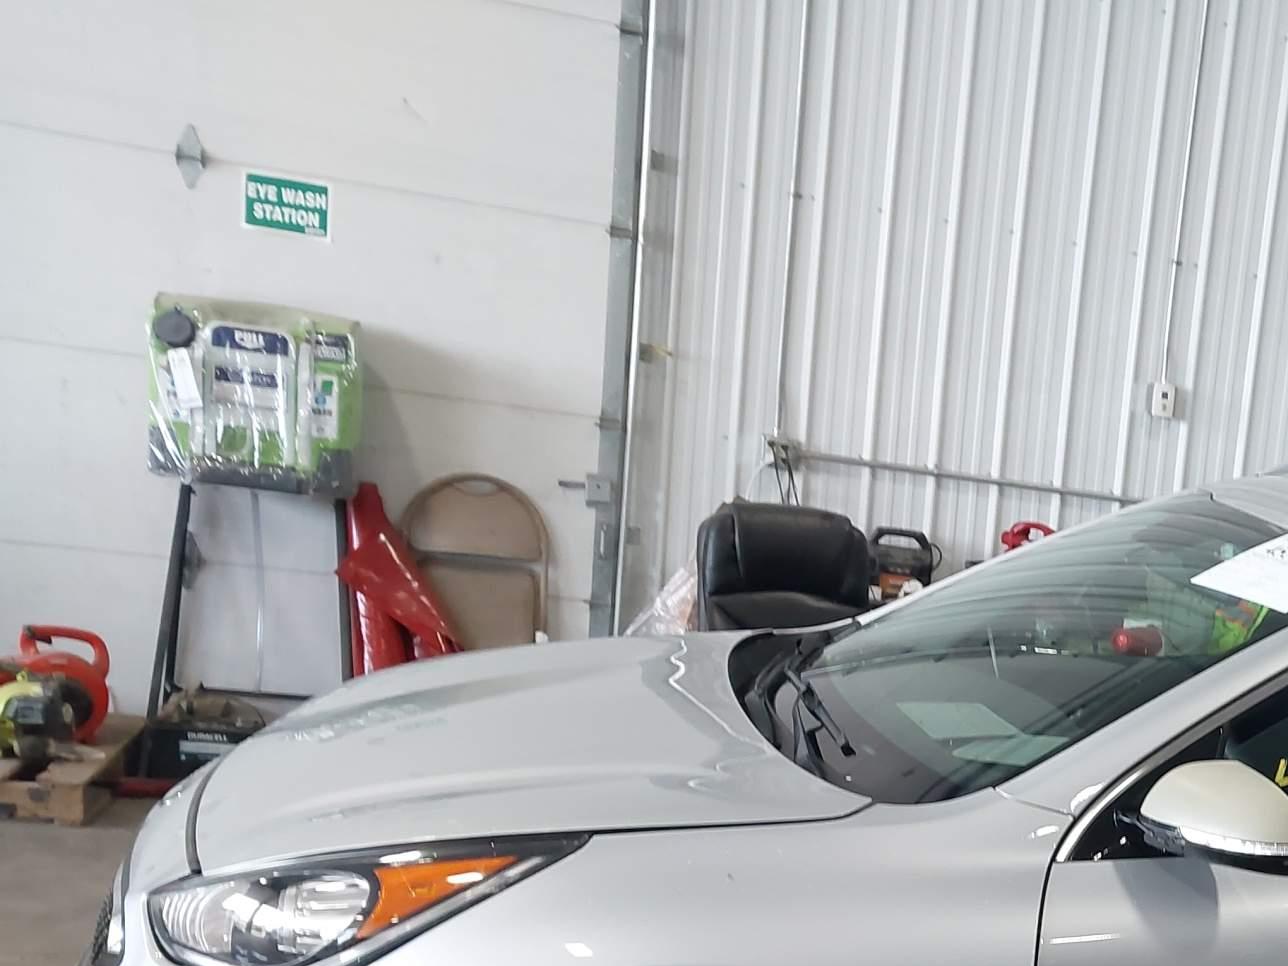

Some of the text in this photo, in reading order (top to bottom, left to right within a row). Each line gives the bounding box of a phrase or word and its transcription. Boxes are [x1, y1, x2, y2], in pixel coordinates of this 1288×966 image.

[246, 180, 328, 211] EYE WASH
[252, 201, 321, 228] STATION
